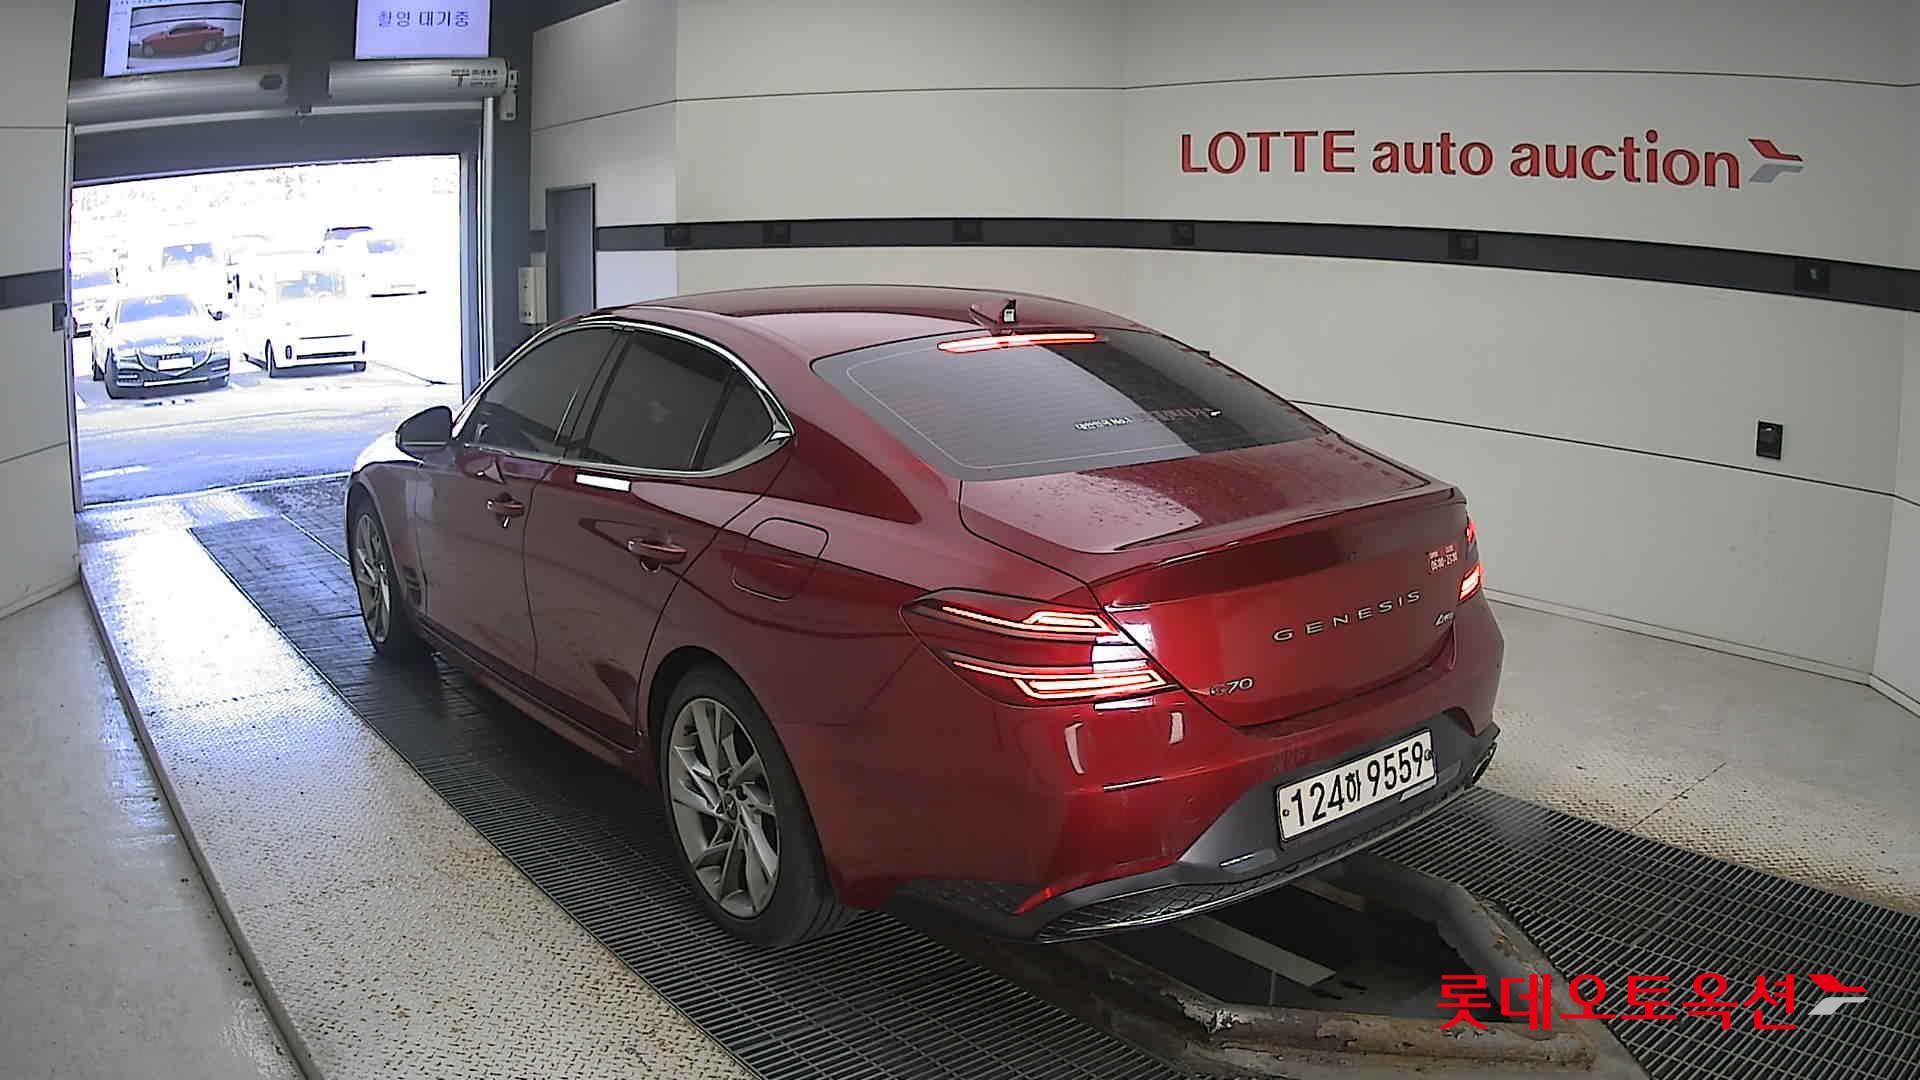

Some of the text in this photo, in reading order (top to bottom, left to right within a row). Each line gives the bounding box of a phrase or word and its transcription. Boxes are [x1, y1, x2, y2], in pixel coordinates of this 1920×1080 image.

[419, 10, 470, 28] 대기중
[1180, 129, 1741, 189] LOTTE auto auction
[1273, 590, 1421, 641] GENESIS
[1291, 741, 1424, 827] 124하 9559
